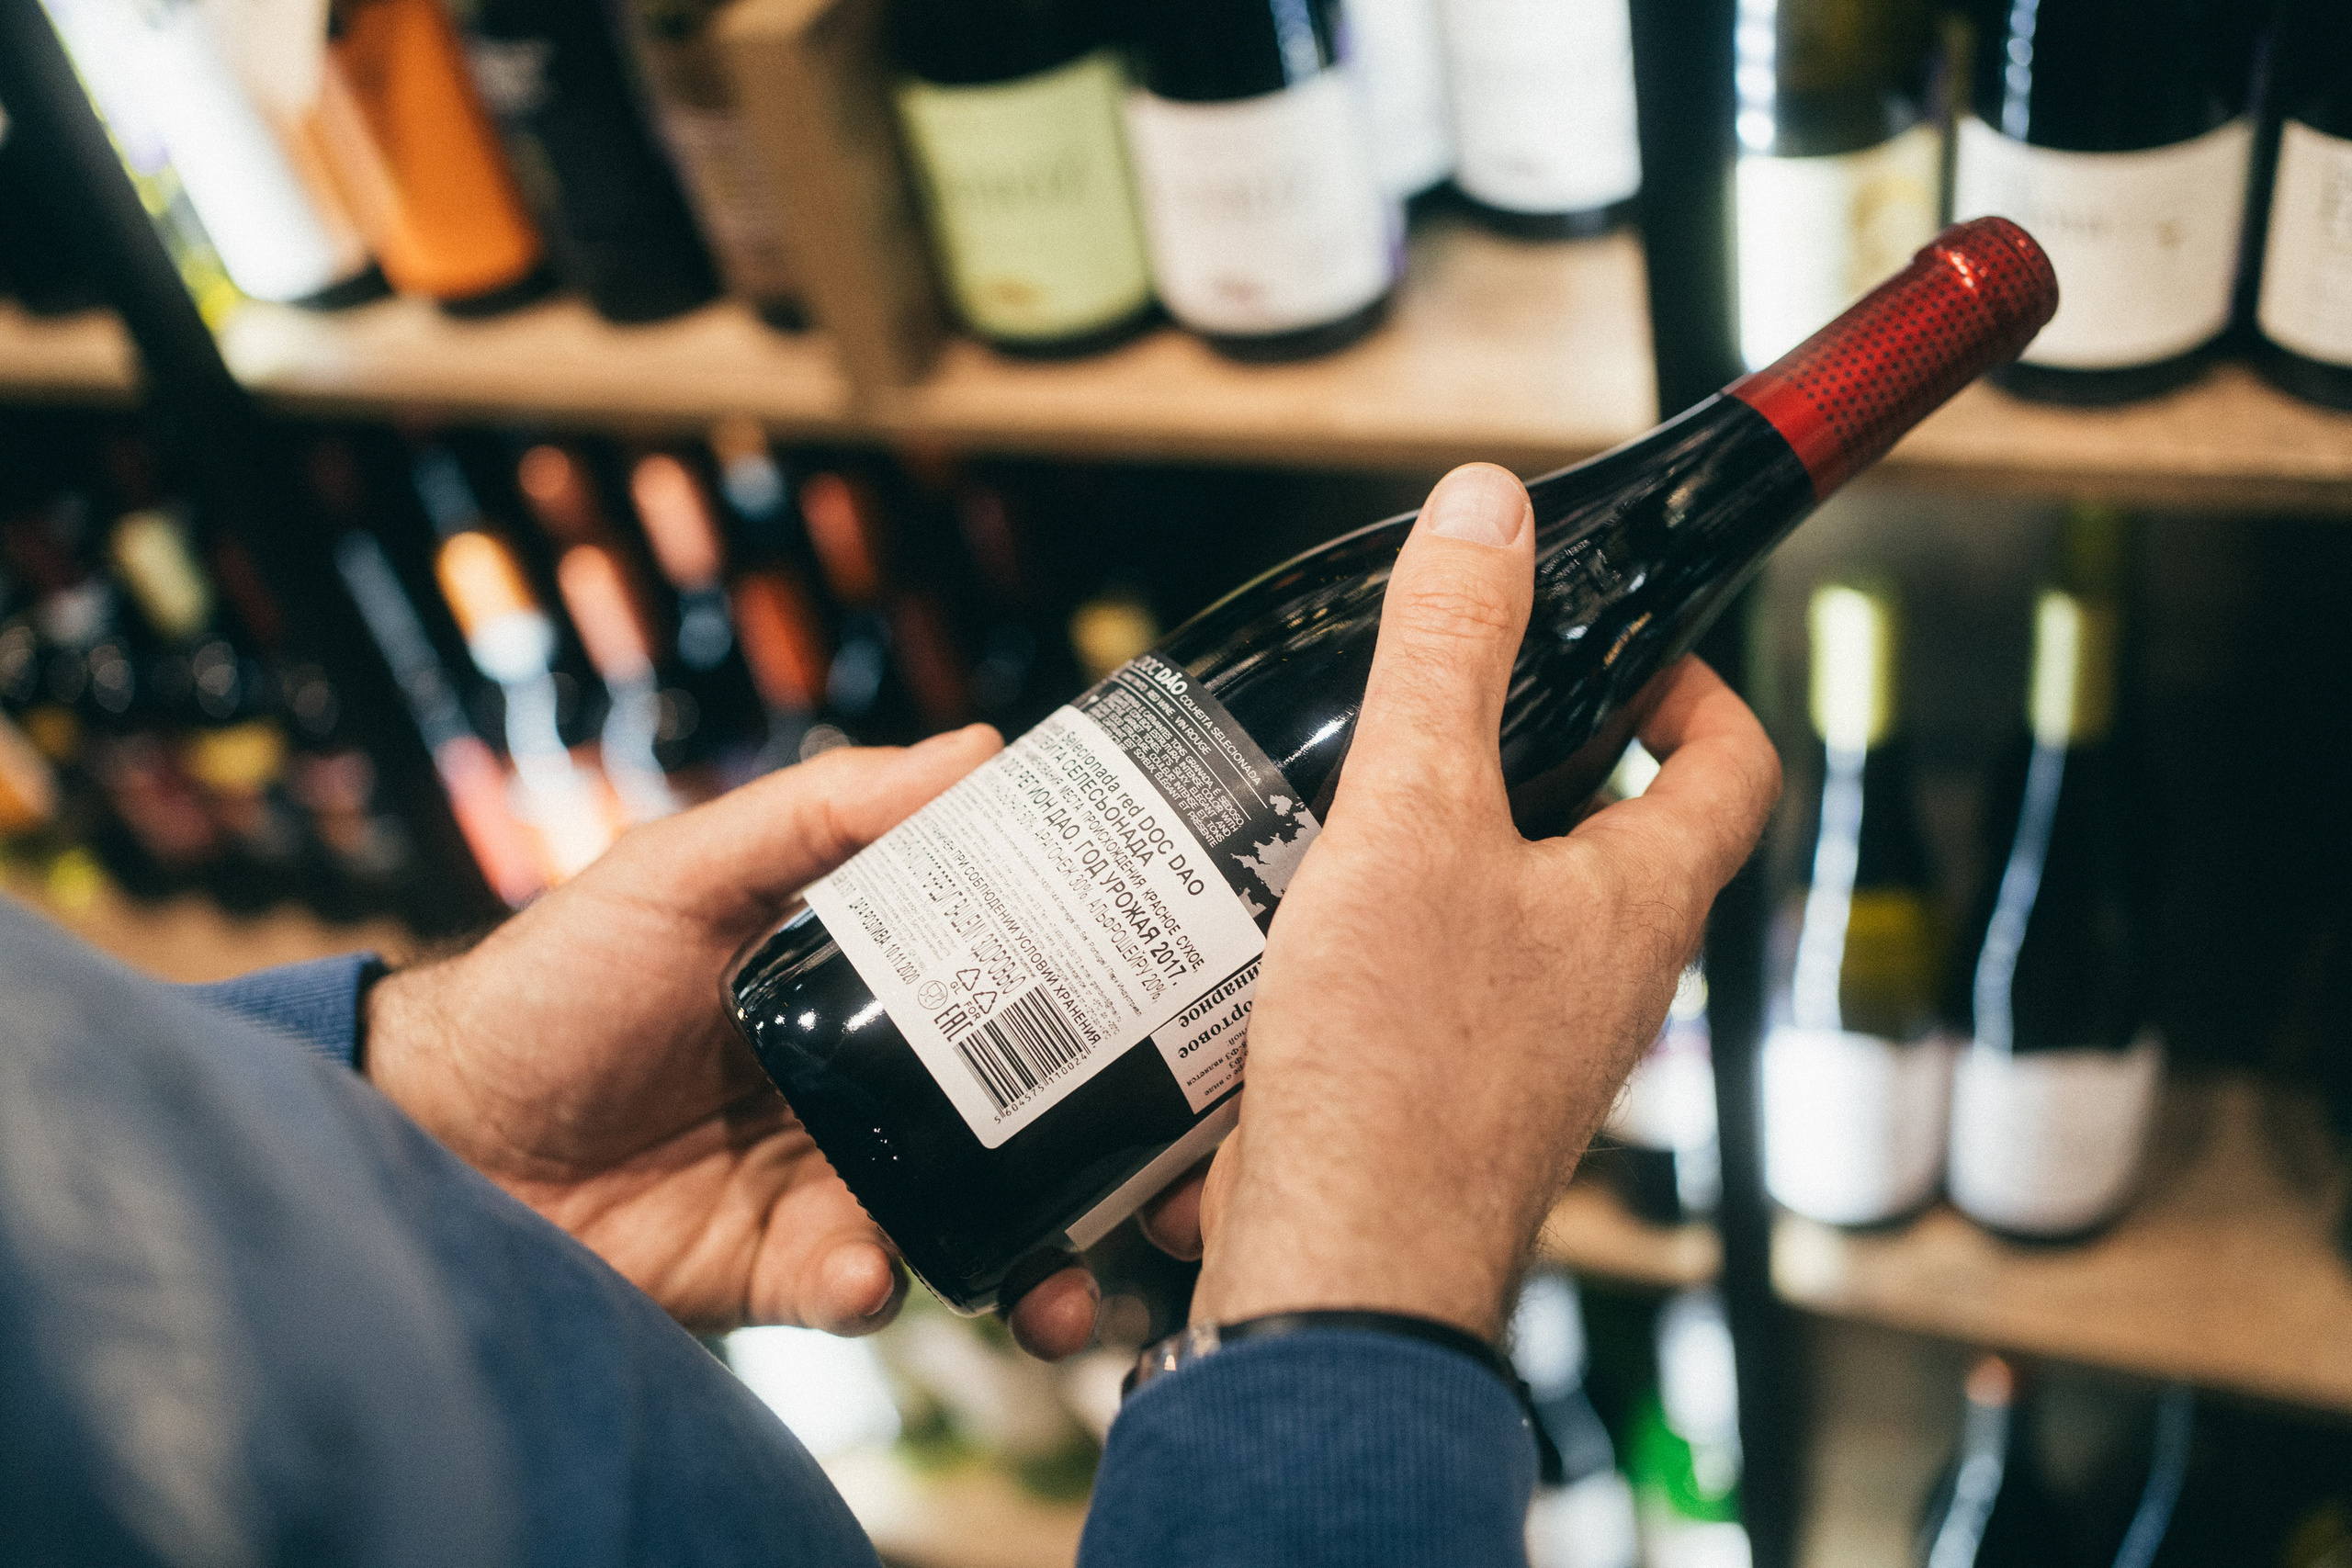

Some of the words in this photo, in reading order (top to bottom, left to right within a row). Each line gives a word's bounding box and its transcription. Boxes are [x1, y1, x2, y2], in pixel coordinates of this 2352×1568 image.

[1153, 666, 1189, 697] DÃO
[1179, 693, 1214, 729] COLHEITA
[1209, 726, 1261, 785] SELECIONADA
[1156, 698, 1175, 716] WINE
[1173, 716, 1189, 730] VIN
[1184, 727, 1211, 755] ROUGE
[1170, 738, 1187, 756] TONS
[1212, 787, 1222, 796] É
[1060, 757, 1157, 867] СЕЛЕСЬОНАДА
[1060, 729, 1123, 793] Selecionada
[1116, 791, 1145, 818] red
[1137, 814, 1175, 856] DOC
[1167, 853, 1206, 897] DAO
[1123, 738, 1136, 750] EST
[1153, 771, 1182, 801] ÉLÉGANT
[1178, 800, 1190, 812] ET
[1186, 810, 1218, 848] PRÉSENTE
[1138, 718, 1153, 731] BOA
[1178, 761, 1204, 788] INTENSE
[1200, 787, 1224, 813] COLOR
[1220, 811, 1238, 832] WITH
[1148, 752, 1176, 782] COULEUR
[1173, 781, 1199, 809] INTENSE
[1196, 808, 1207, 820] ET
[1204, 819, 1225, 842] TONS
[1188, 786, 1217, 818] ELEGANT
[1215, 818, 1231, 837] AND
[922, 869, 963, 910] ВРЕДИТ
[943, 897, 989, 945] ВАШЕМУ
[1012, 769, 1058, 814] РЕГИОН
[1042, 806, 1084, 845] ДАО.
[1074, 839, 1109, 879] ГОД
[1098, 871, 1160, 944] УРОЖАЯ
[1149, 940, 1189, 986] 2017.
[1031, 827, 1080, 881] АРАГОНЕЖ
[1085, 896, 1152, 979] АЛЬФРОШЕЙРУ
[1140, 972, 1168, 1004] 20%,
[1057, 784, 1084, 812] МЕСТА
[1080, 809, 1147, 889] ПРОИСХОЖДЕНИЯ
[1141, 887, 1181, 935] КРАСНОЕ
[1174, 934, 1205, 973] СУХОЕ,
[846, 896, 870, 916] ДАТА
[883, 942, 921, 986] 10.11.2020
[950, 850, 969, 868] ПРИ
[963, 865, 1020, 934] СОБЛЮДЕНИИ
[1014, 931, 1059, 986] УСЛОВИЙ
[1053, 984, 1103, 1048] ХРАНЕНИЯ.
[948, 980, 962, 995] GL
[963, 1000, 981, 1021] FOR
[1178, 999, 1252, 1059] ортовое
[1179, 962, 1262, 1028] инарное
[1046, 1051, 1089, 1087] 110024
[1185, 1057, 1224, 1087] является
[1203, 1079, 1225, 1096] виде
